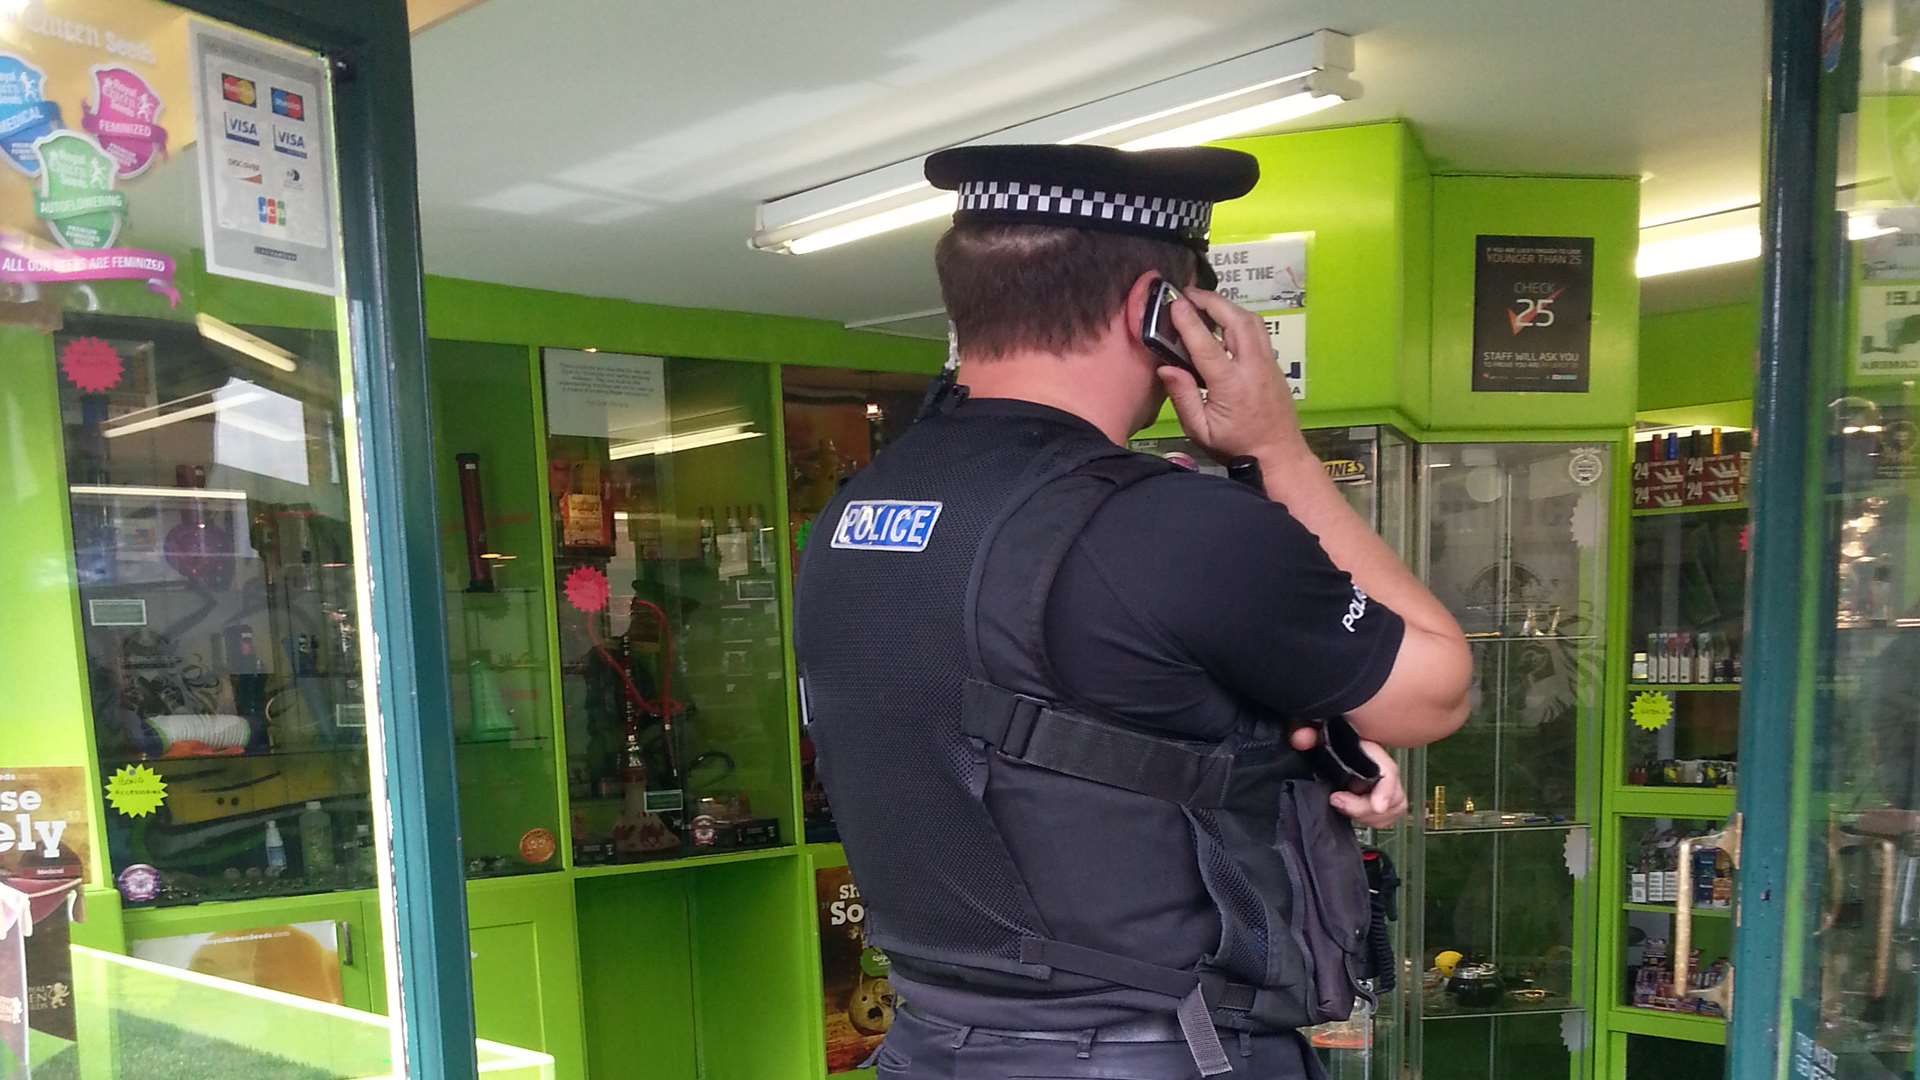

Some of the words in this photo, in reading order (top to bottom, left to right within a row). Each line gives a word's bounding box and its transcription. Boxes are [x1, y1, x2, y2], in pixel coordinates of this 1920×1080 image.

[99, 119, 151, 136] FEMINIZED
[230, 118, 258, 136] VISA
[278, 131, 305, 148] VISA
[2, 257, 24, 272] ALL
[89, 256, 109, 270] ARE
[112, 256, 165, 271] FEMINIZED
[1211, 251, 1248, 267] EASE
[1487, 254, 1535, 265] YOUNGER
[1537, 254, 1566, 265] THAN
[1568, 254, 1582, 266] 25
[1246, 266, 1274, 282] THE
[1514, 281, 1554, 295] CHECK
[1516, 298, 1555, 328] 25
[1483, 352, 1513, 361] STAFF
[1515, 352, 1536, 361] WILL
[1539, 352, 1558, 361] ASK
[1560, 352, 1579, 362] YOU
[1633, 462, 1649, 481] 24
[1688, 456, 1704, 475] 24
[1634, 486, 1650, 504] 24
[1688, 481, 1703, 498] 24
[838, 505, 932, 544] POLICE
[0, 790, 42, 811] se
